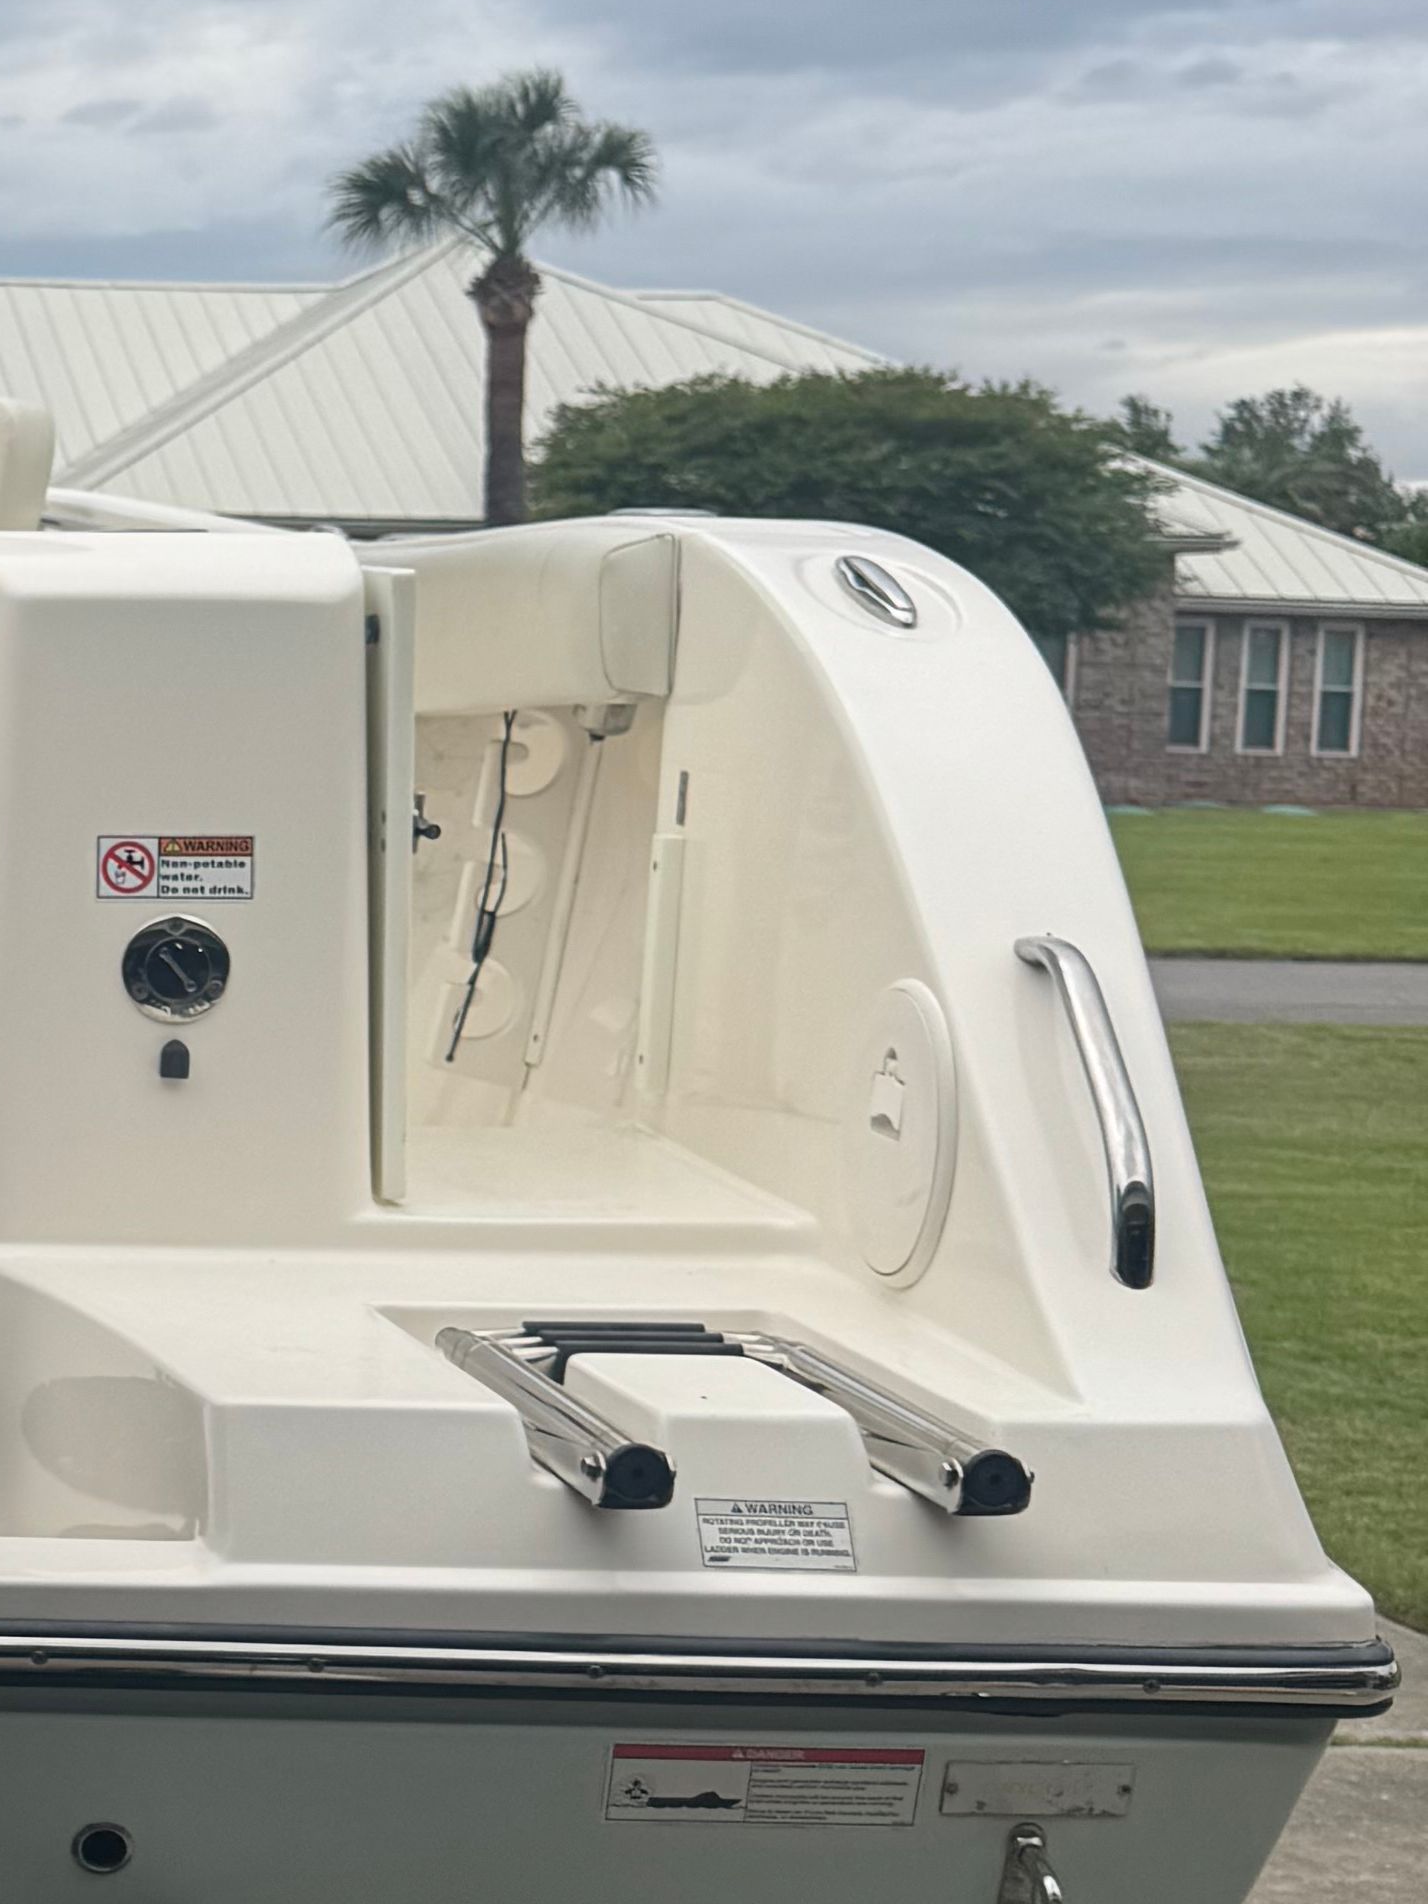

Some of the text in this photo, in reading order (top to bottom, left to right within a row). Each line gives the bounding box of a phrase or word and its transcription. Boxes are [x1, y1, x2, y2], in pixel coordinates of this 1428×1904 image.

[183, 840, 250, 852] WARNING
[161, 859, 247, 870] Non-potable
[161, 872, 203, 882] water.
[161, 885, 249, 895] Do not drink.
[745, 1502, 814, 1516] WARNING
